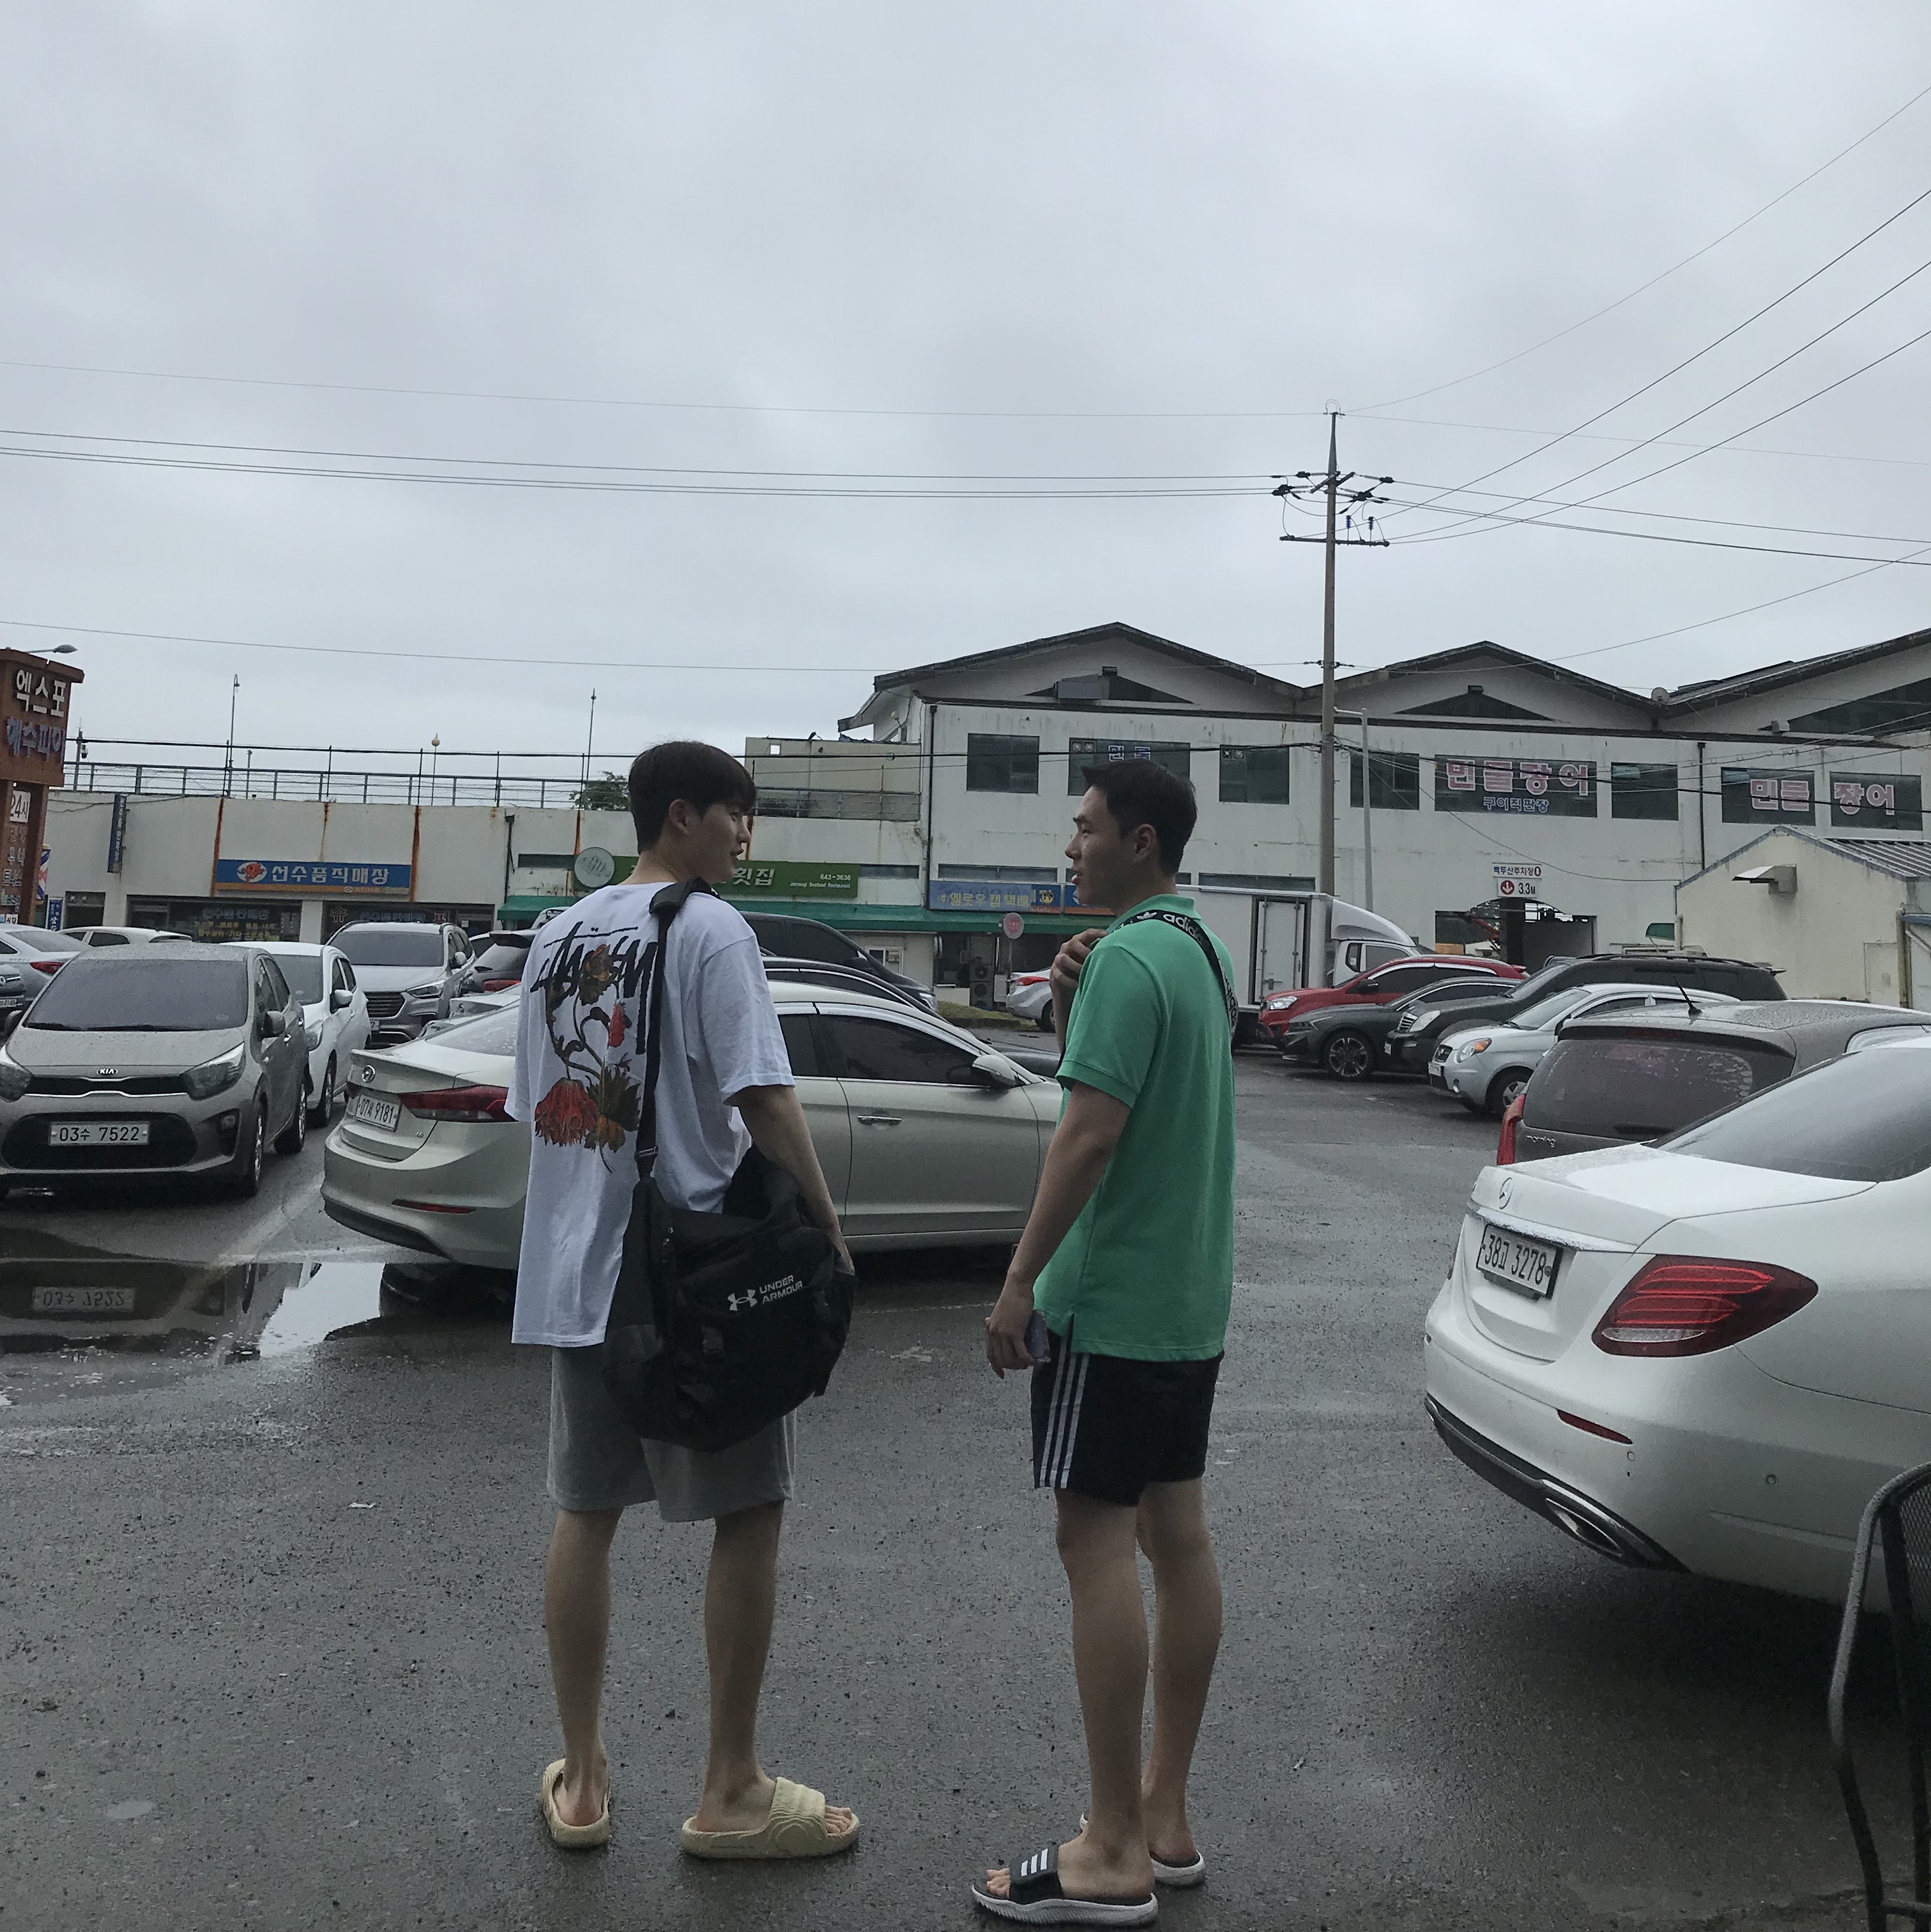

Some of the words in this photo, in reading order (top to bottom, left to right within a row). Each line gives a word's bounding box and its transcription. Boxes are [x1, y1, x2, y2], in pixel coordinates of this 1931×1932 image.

[16, 669, 66, 717] 엑스포
[1446, 758, 1589, 796] 민물장어
[1483, 797, 1550, 813] 구이직판장
[1750, 778, 1810, 812] 민물
[1833, 781, 1895, 816] 장어
[720, 866, 775, 886] 횟집
[374, 1102, 395, 1124] 9181
[59, 1127, 90, 1142] 03수
[99, 1127, 140, 1142] 7522
[1511, 1243, 1546, 1285] 3278
[759, 1275, 794, 1294] UNDER
[762, 1280, 803, 1304] ARMOUR
